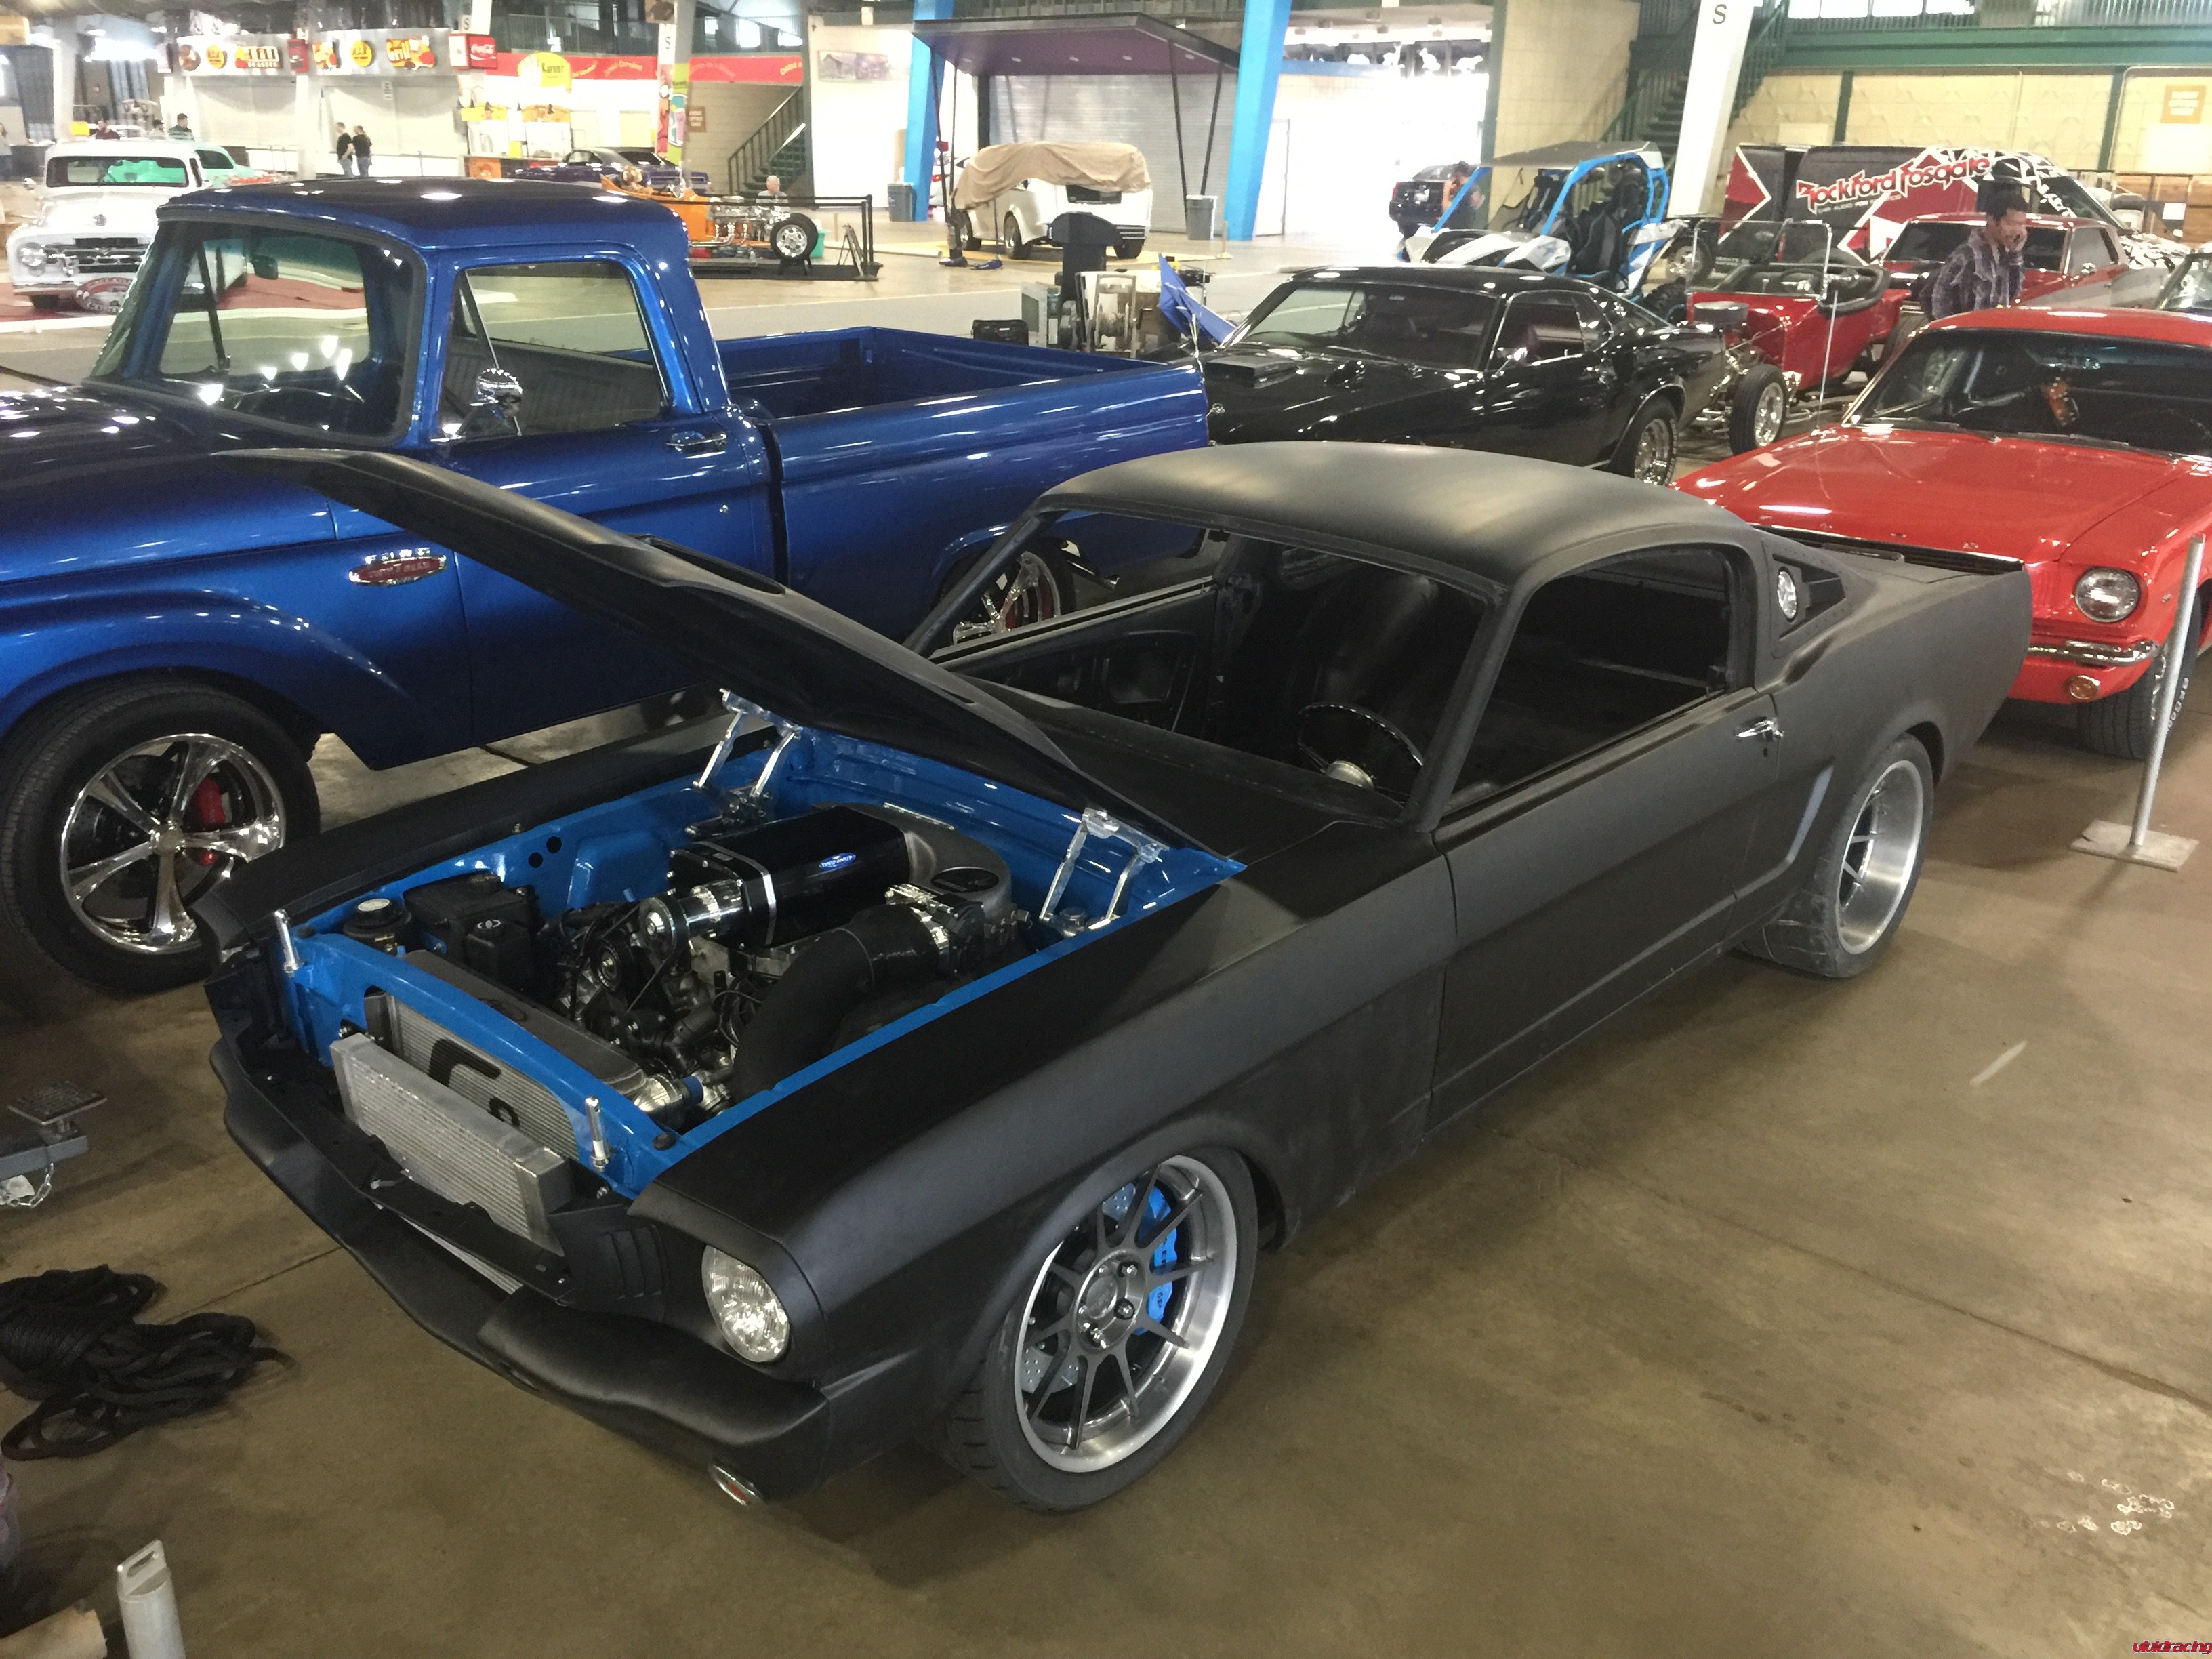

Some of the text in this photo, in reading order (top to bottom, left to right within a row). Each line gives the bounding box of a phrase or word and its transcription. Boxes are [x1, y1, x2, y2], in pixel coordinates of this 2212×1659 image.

[1713, 3, 1727, 24] S
[665, 36, 671, 49] S
[1797, 169, 1897, 214] Rockford
